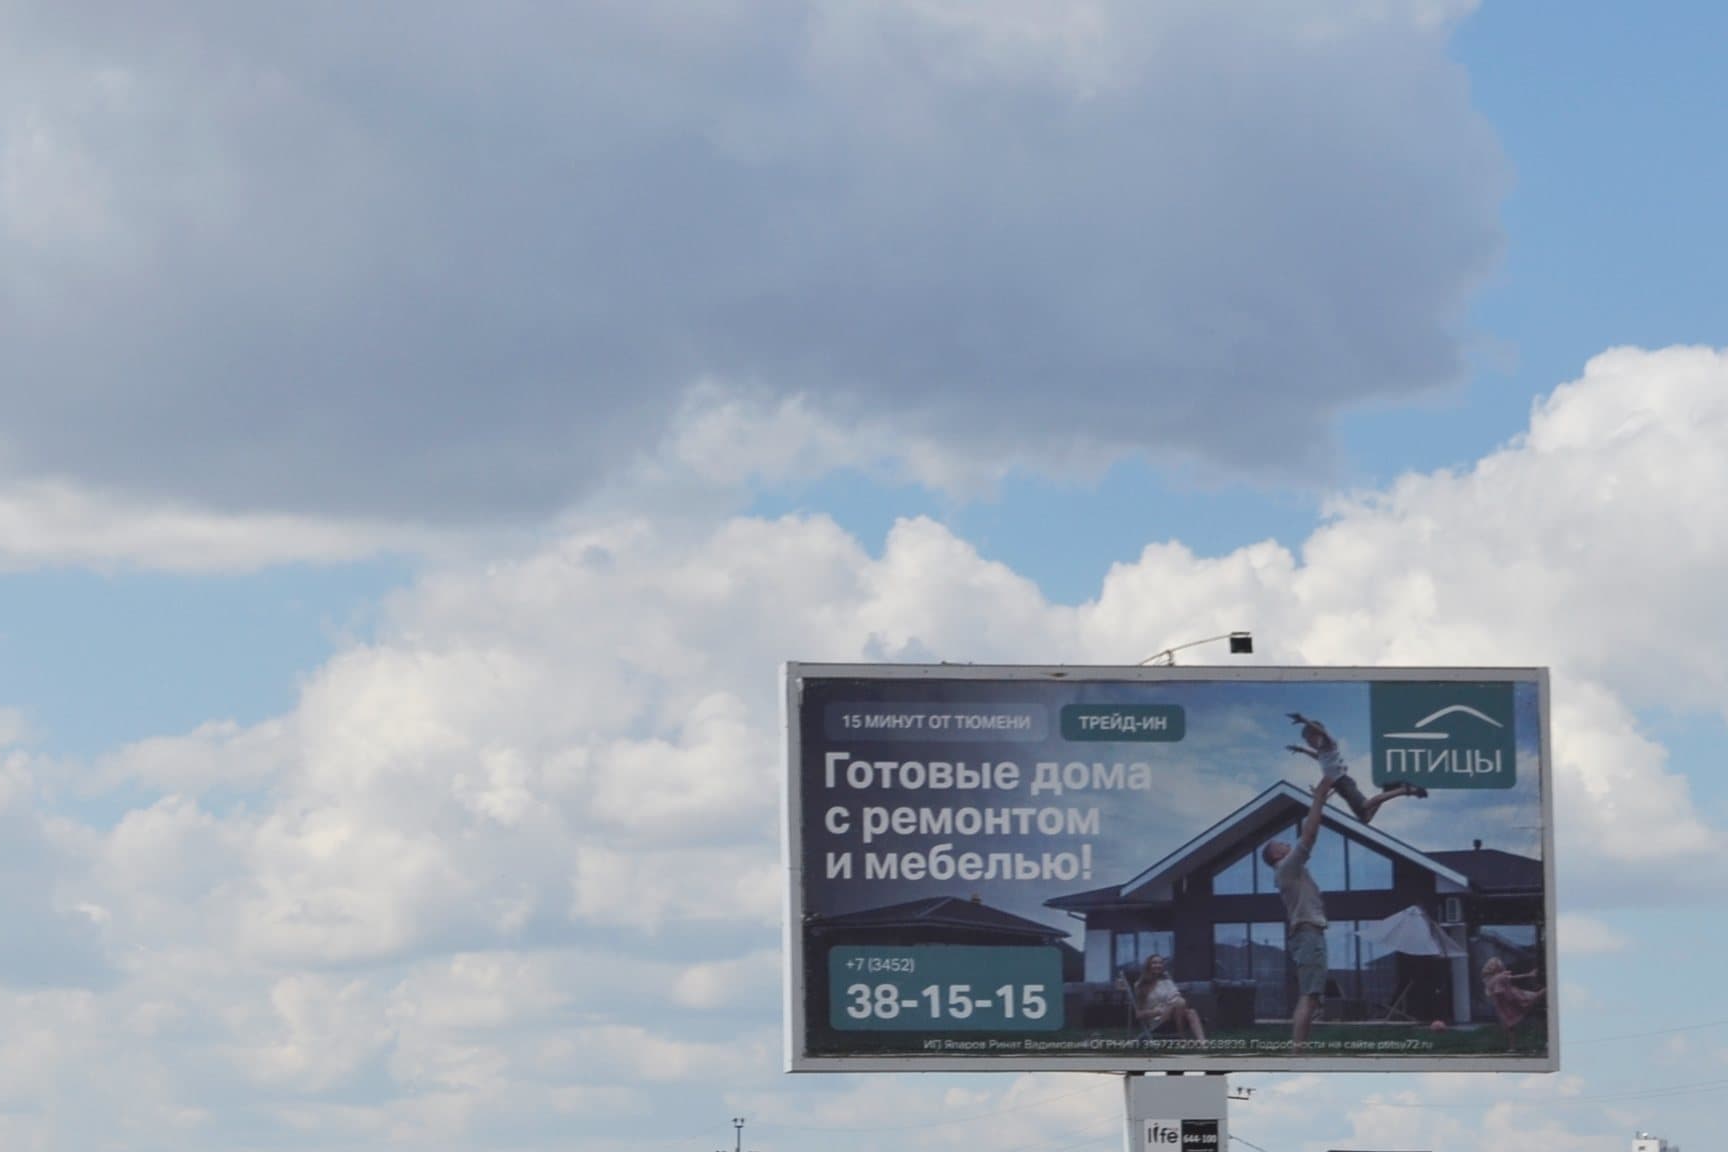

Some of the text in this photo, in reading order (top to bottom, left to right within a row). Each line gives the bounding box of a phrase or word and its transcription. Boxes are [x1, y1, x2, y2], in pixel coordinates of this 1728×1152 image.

[842, 714, 1031, 730] 15 МИНУТ ОТ ТЮМЕНИ
[1078, 712, 1168, 732] ТРЕЙД-ИН
[824, 752, 1153, 796] Готовые дома
[1385, 748, 1502, 777] ПТИЦЫ
[824, 805, 1100, 843] с ремонтом
[825, 843, 1093, 881] и мебелью!
[845, 957, 916, 973] +7 (3452)
[846, 983, 1048, 1019] 38-15-15
